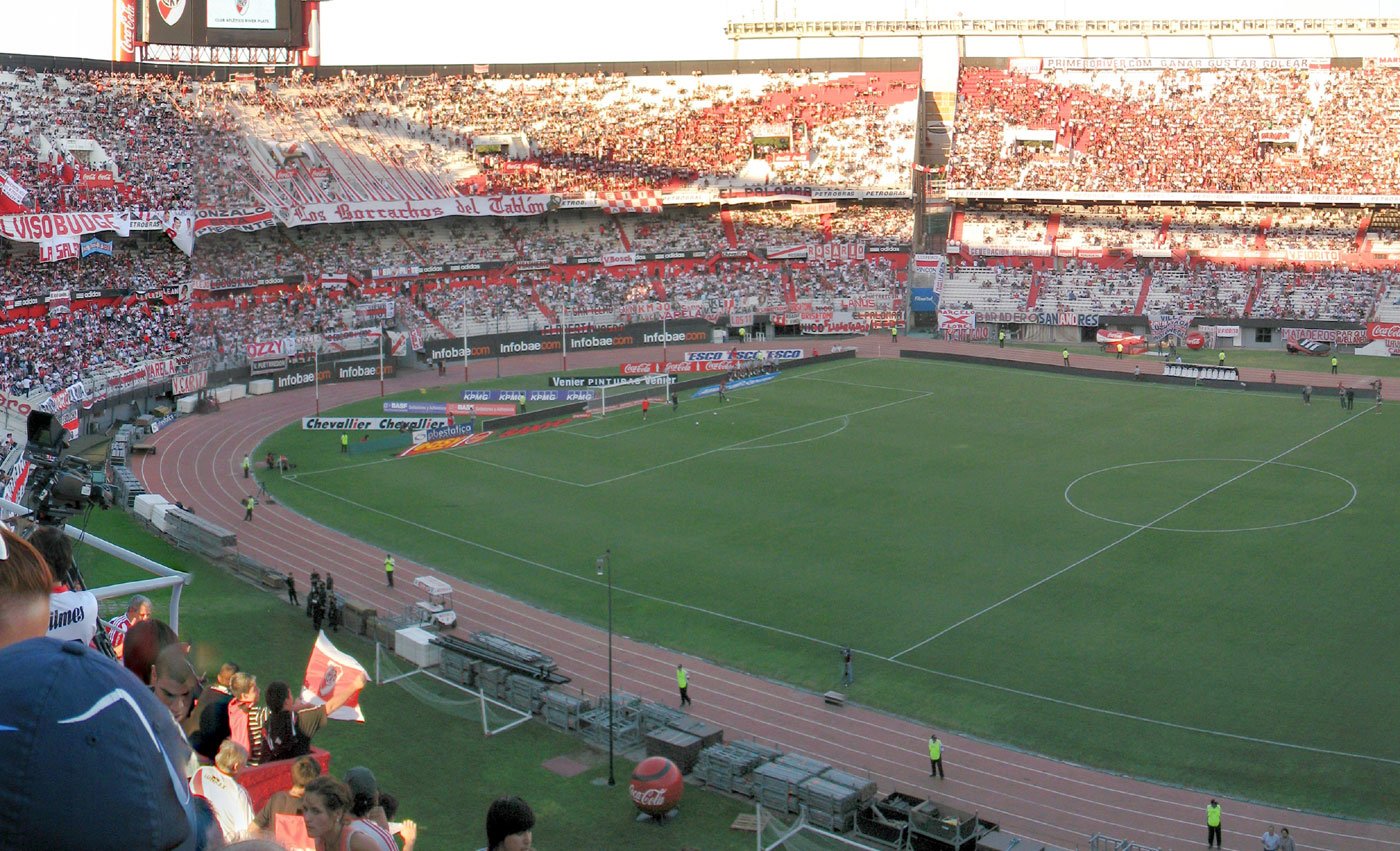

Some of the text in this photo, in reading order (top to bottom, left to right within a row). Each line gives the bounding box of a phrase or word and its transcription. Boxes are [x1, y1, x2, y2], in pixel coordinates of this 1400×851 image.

[1161, 59, 1202, 67] GANAR
[1208, 59, 1256, 67] GUSTAR
[1263, 59, 1308, 67] GOLEAR
[745, 186, 812, 197] PALOMAR
[294, 206, 327, 222] Los
[336, 201, 444, 220] Borrachos
[457, 197, 480, 214] del
[808, 244, 864, 255] ROSARIO
[841, 299, 876, 308] LANUS
[975, 312, 1038, 323] BARADERO
[1281, 328, 1336, 341] MATADEROS
[247, 340, 283, 358] OZZY
[689, 351, 723, 360] ESCO
[767, 350, 800, 359] ESCO
[145, 361, 175, 378] VARELA
[624, 362, 651, 373] Coca-Cola
[665, 361, 691, 372] Coca-Cola
[552, 376, 584, 386] Venier
[463, 392, 592, 401] KPMG KPMG KPMG
[306, 418, 372, 430] Chevallier
[48, 605, 85, 632] ilmes
[628, 784, 668, 806] Coca-Cola
